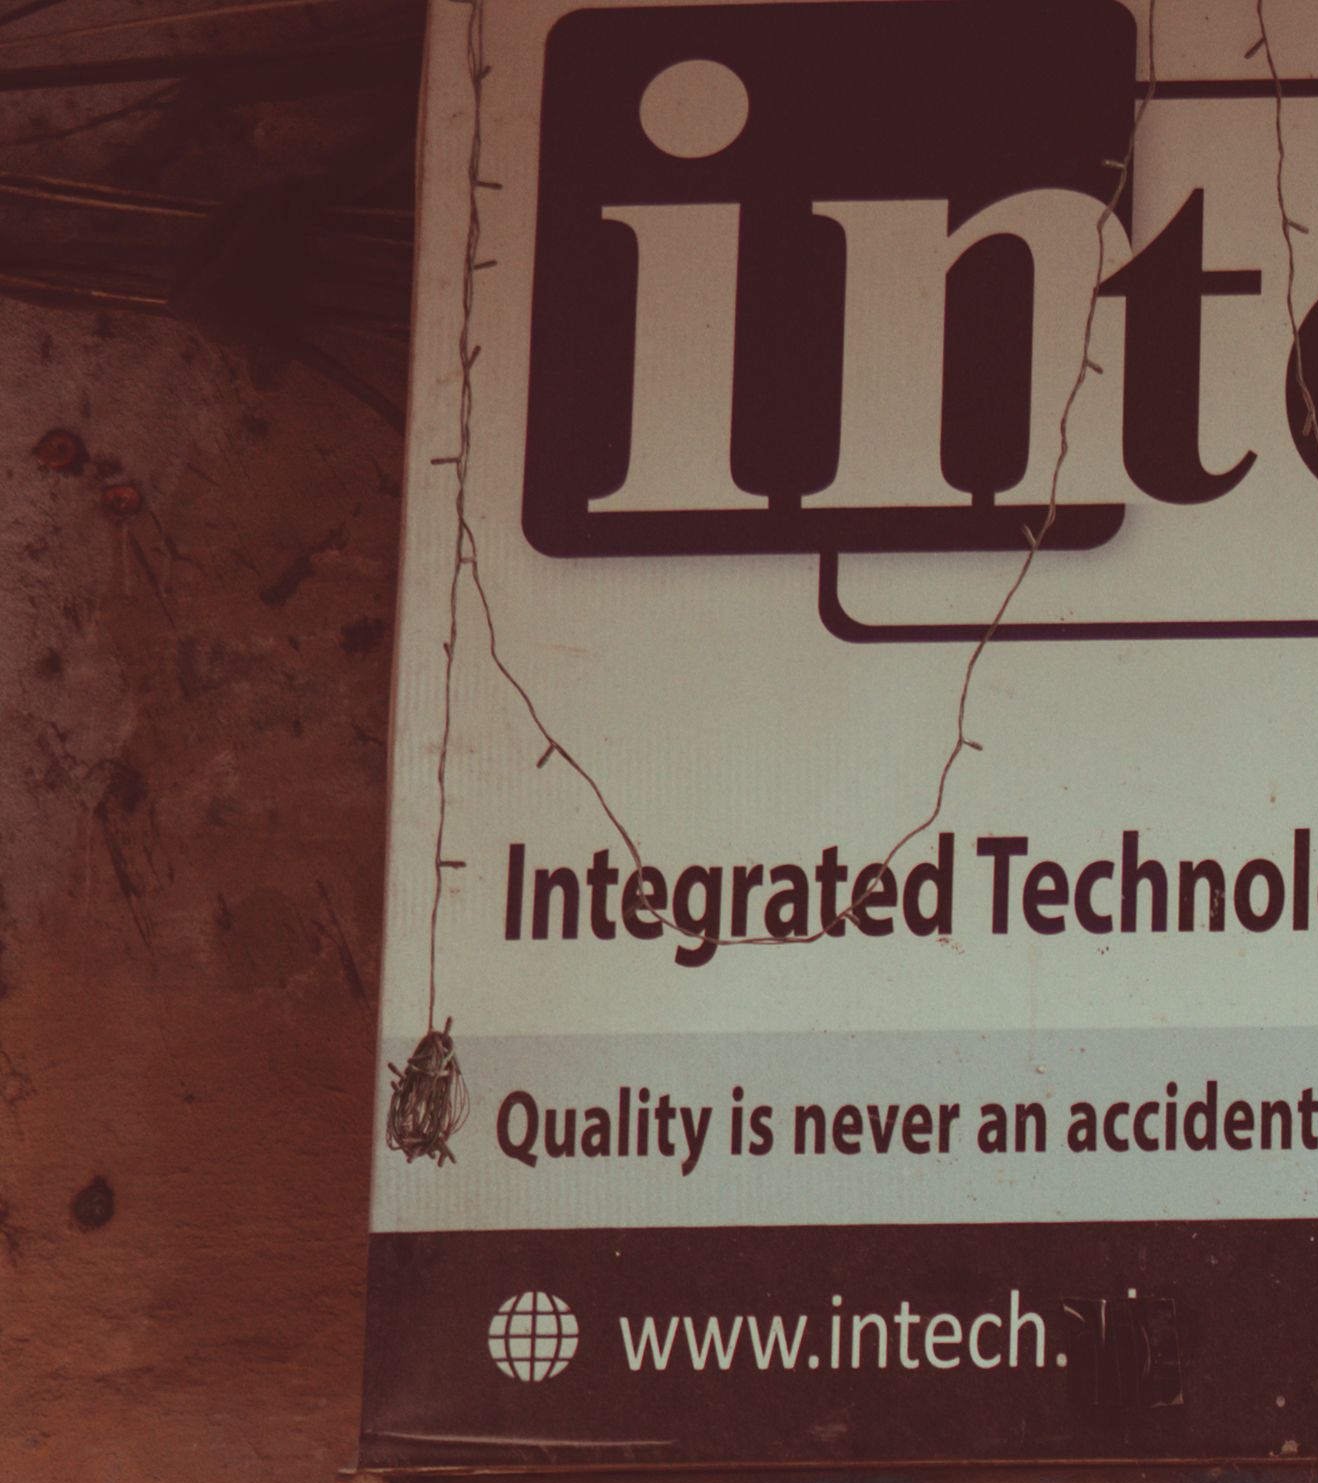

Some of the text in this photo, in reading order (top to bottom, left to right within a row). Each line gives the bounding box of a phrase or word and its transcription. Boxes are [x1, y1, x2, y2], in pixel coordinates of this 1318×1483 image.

[504, 830, 955, 968] Integrated
[495, 1084, 713, 1178] Quality
[730, 1085, 774, 1157] is
[794, 1103, 961, 1156] never
[977, 1101, 1047, 1154] an
